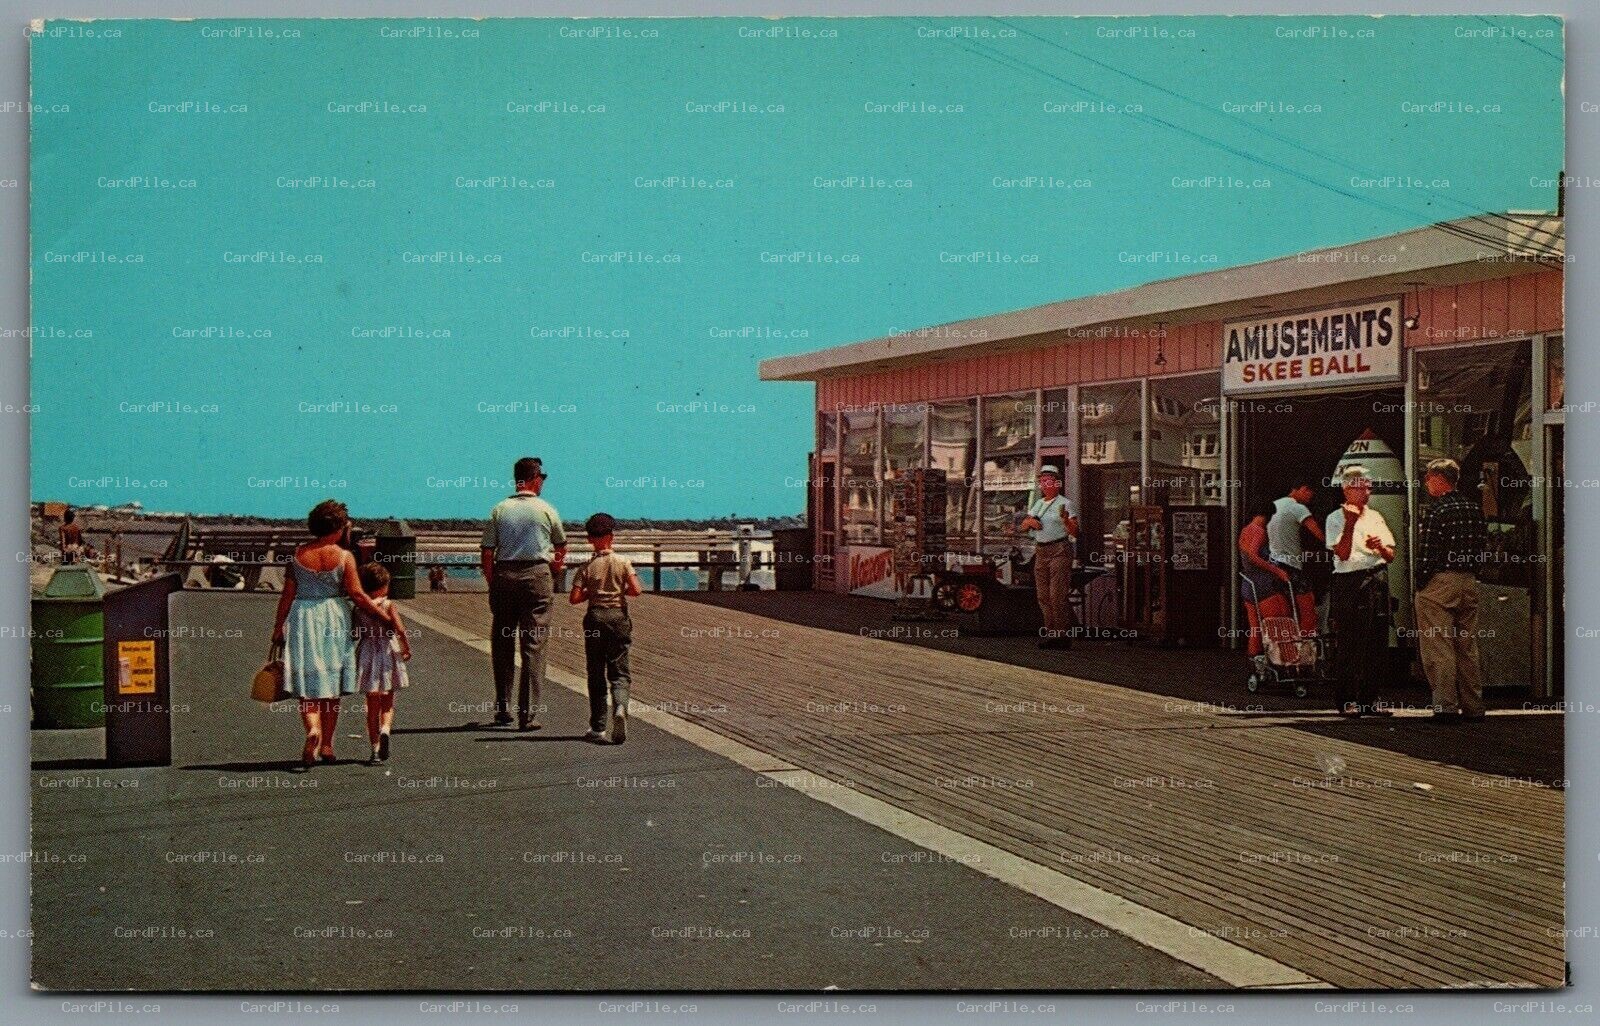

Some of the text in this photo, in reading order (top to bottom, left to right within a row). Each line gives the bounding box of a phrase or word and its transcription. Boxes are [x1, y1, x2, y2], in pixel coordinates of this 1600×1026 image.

[1226, 307, 1393, 363] AMUSEMENTS
[1243, 353, 1370, 383] SKEE BALL
